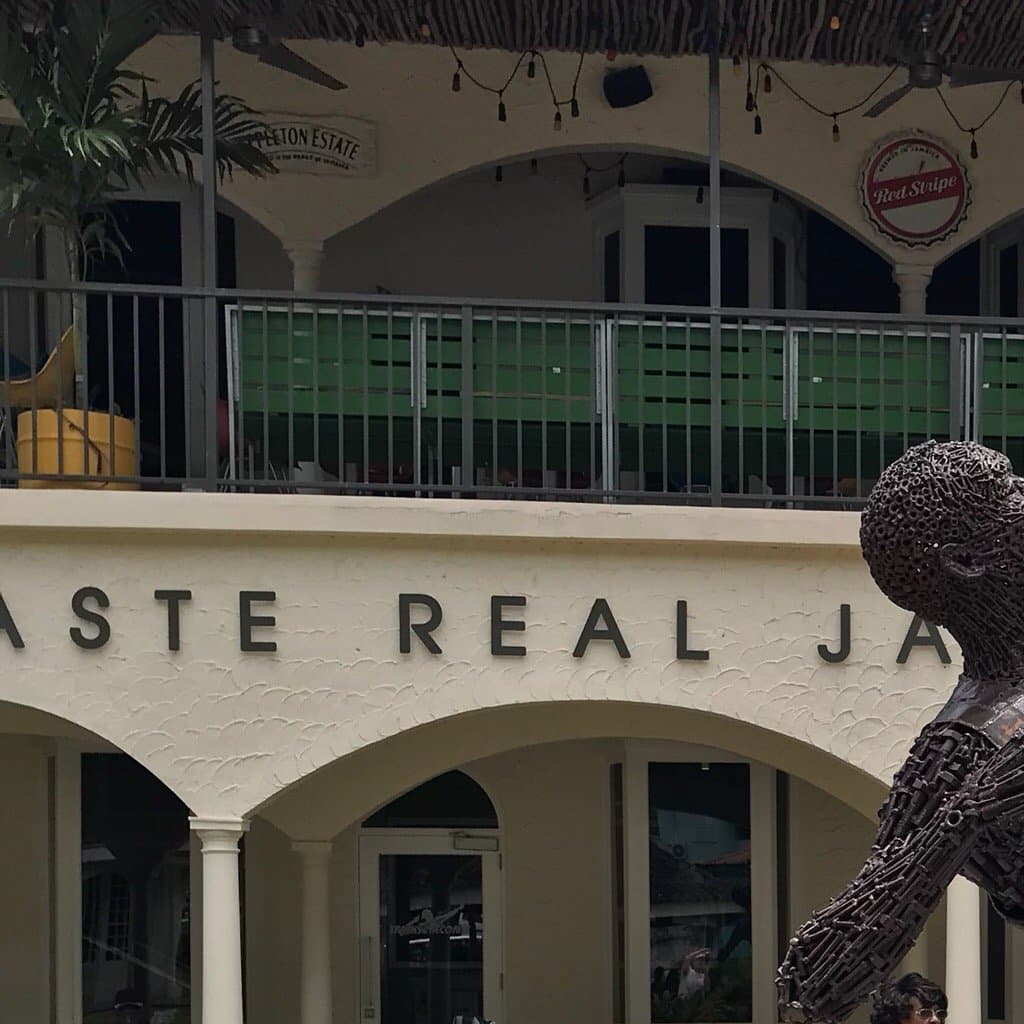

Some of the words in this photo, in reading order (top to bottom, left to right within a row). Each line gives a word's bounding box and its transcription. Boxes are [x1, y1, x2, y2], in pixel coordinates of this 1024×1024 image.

[254, 127, 308, 149] PLETON
[311, 126, 361, 160] ESTATE
[873, 185, 907, 205] Red
[909, 175, 957, 197] Stripe
[398, 593, 712, 661] REAL
